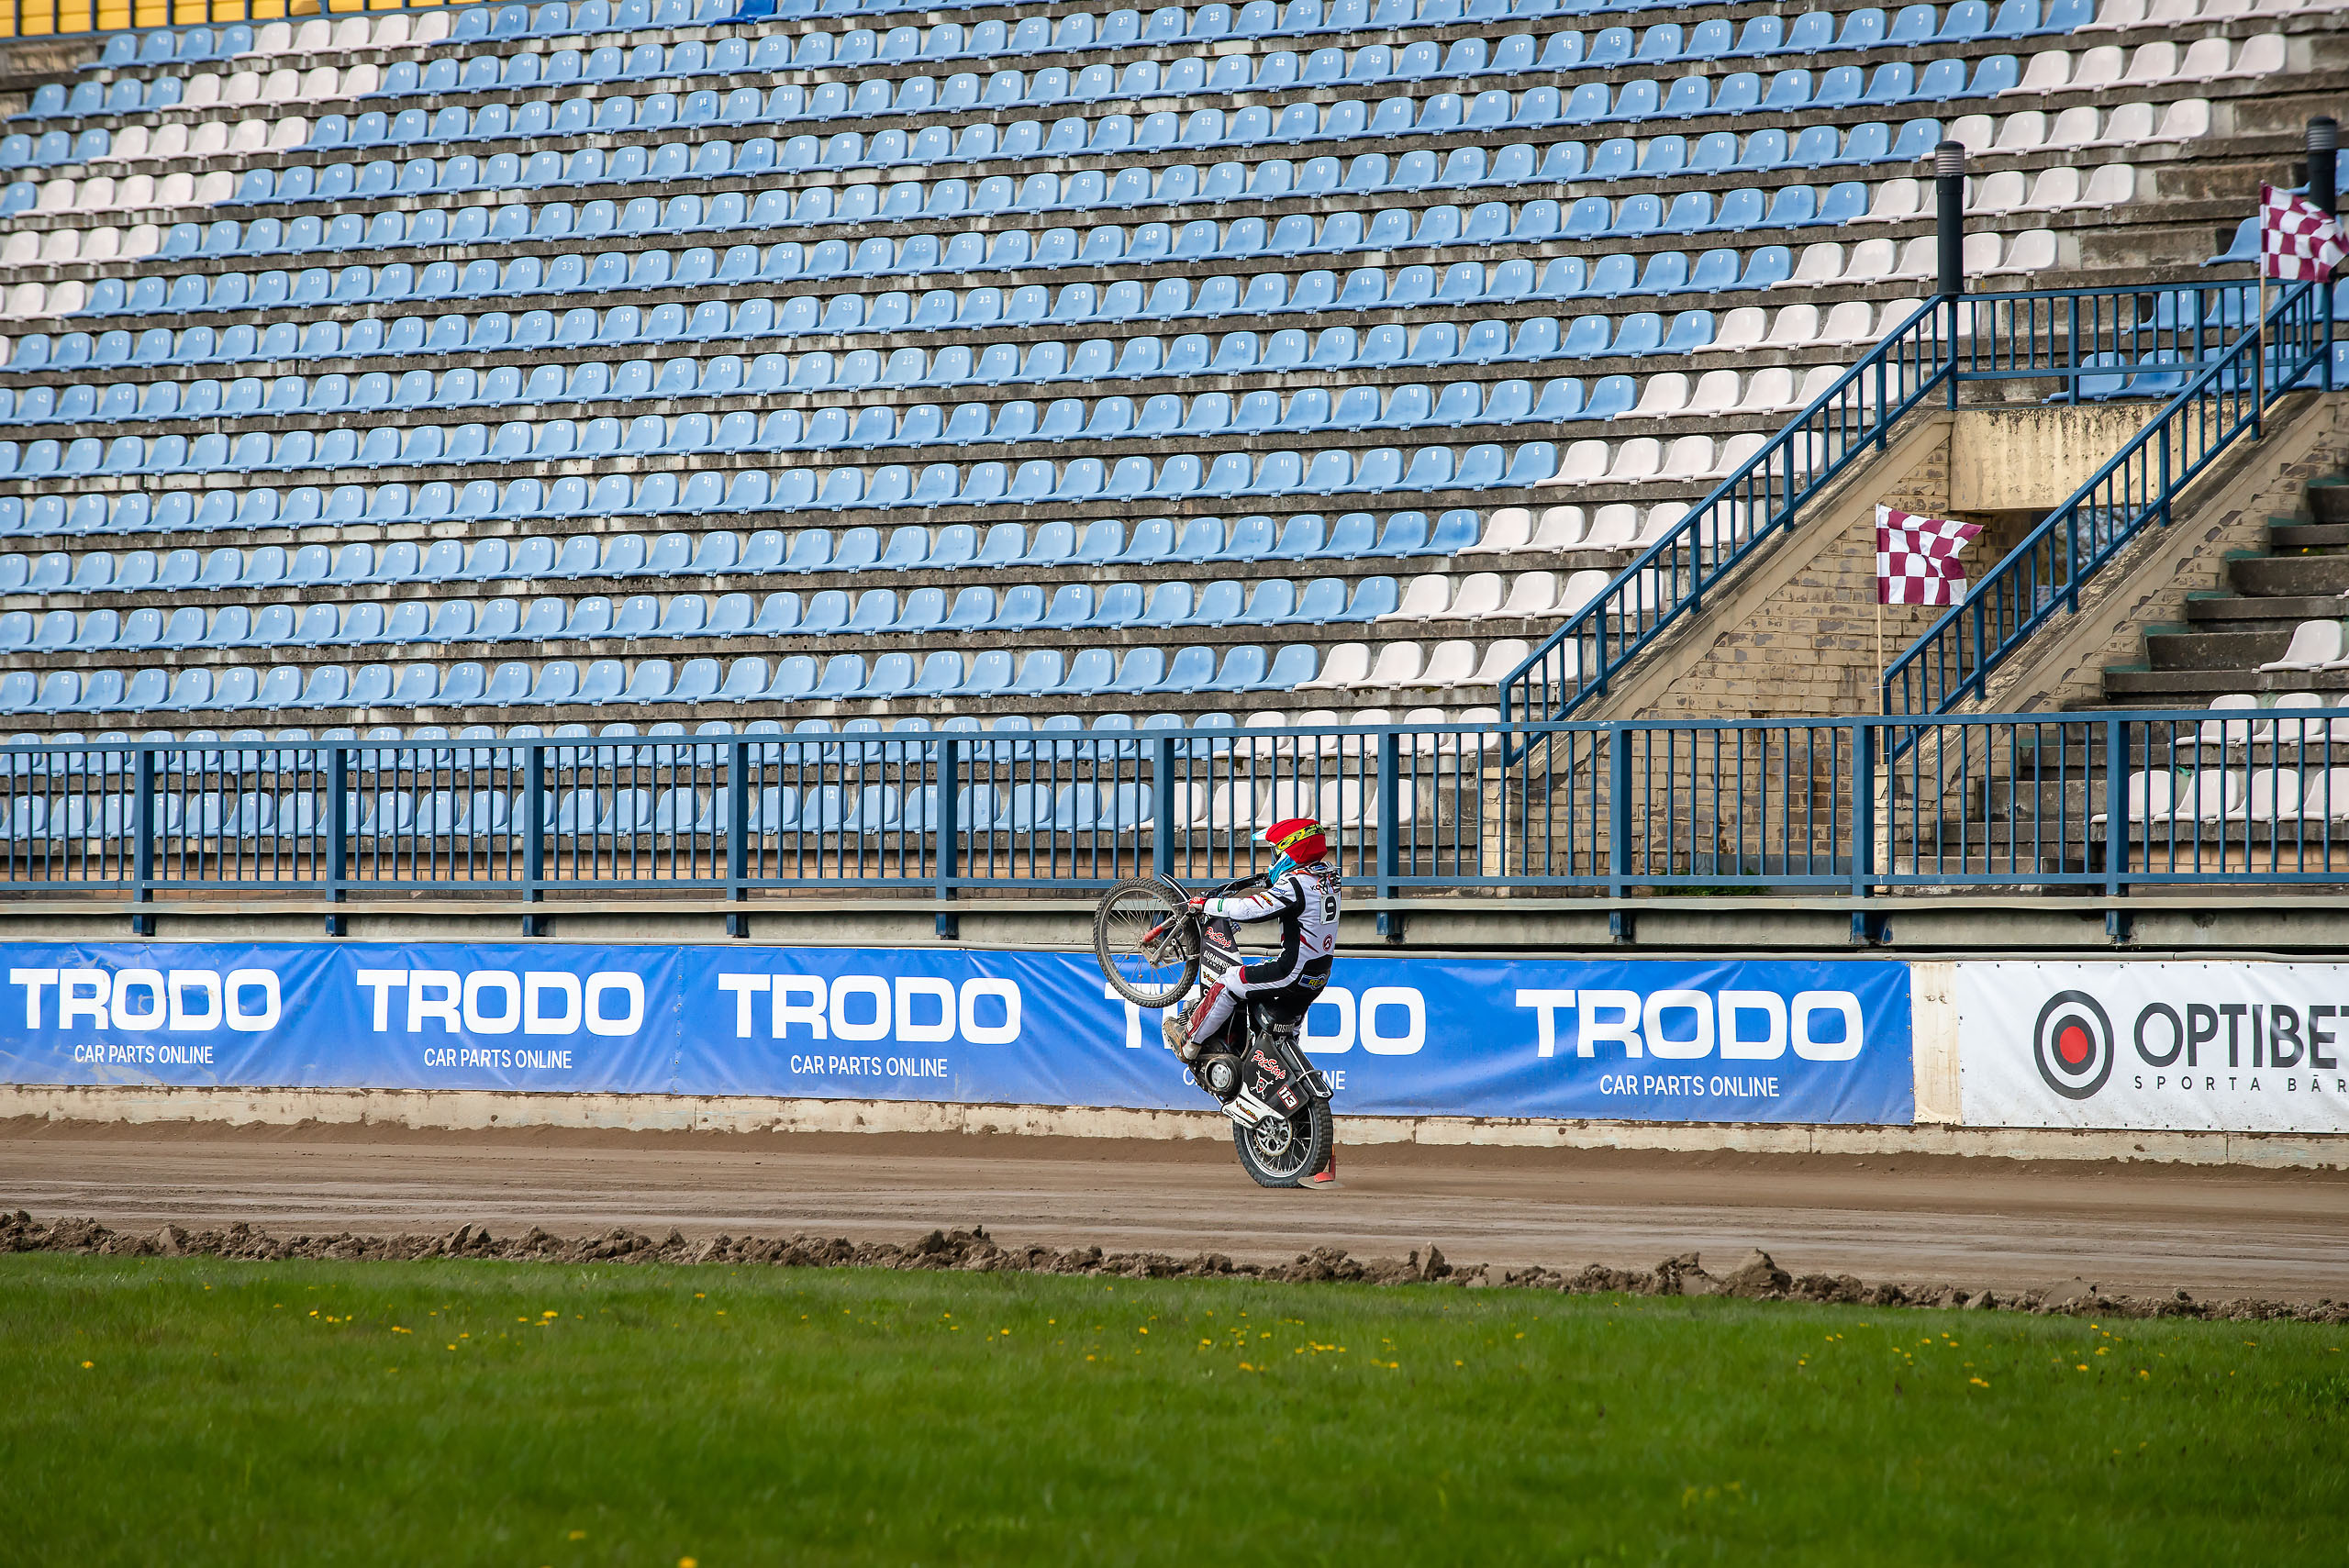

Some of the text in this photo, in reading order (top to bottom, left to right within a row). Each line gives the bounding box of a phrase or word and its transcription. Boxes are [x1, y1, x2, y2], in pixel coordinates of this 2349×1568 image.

[1163, 16, 1174, 26] 26
[1209, 11, 1219, 22] 25
[1709, 28, 1720, 38] 13
[1761, 23, 1772, 34] 12
[898, 33, 909, 43] 32
[1609, 35, 1621, 46] 15
[1660, 32, 1672, 43] 14
[1515, 42, 1526, 52] 17
[1563, 39, 1573, 50] 16
[1275, 58, 1286, 67] 22
[1370, 54, 1381, 64] 20
[1184, 65, 1194, 74] 24
[1230, 61, 1239, 71] 23
[1944, 65, 1951, 74] 7
[698, 97, 707, 106] 35
[1108, 121, 1119, 130] 24
[1201, 117, 1211, 126] 22
[1717, 139, 1725, 149] 10
[1081, 178, 1091, 188] 23
[1127, 174, 1138, 184] 22
[1793, 190, 1799, 199] 7
[1845, 190, 1852, 199] 6
[1587, 205, 1596, 213] 11
[1638, 201, 1649, 211] 10
[1486, 209, 1497, 218] 13
[1535, 207, 1545, 217] 12
[1098, 234, 1109, 243] 21
[1145, 229, 1158, 240] 20
[1053, 235, 1065, 245] 22
[604, 259, 615, 269] 32
[1719, 254, 1724, 264] 7
[562, 261, 573, 272] 33
[1512, 266, 1520, 276] 11
[1564, 264, 1575, 274] 10
[1314, 278, 1322, 287] 15
[1361, 276, 1371, 286] 14
[1217, 282, 1226, 291] 17
[1264, 282, 1274, 291] 16
[978, 295, 991, 304] 22
[1027, 293, 1038, 303] 21
[1074, 290, 1086, 300] 20
[842, 301, 853, 311] 25
[933, 298, 945, 307] 23
[1641, 317, 1647, 328] 7
[1691, 317, 1698, 328] 6
[1383, 332, 1392, 343] 12
[1436, 330, 1444, 340] 11
[1486, 329, 1495, 339] 10
[1186, 343, 1196, 352] 16
[1236, 340, 1245, 350] 15
[1563, 382, 1569, 392] 7
[1259, 395, 1268, 406] 13
[1360, 391, 1368, 401] 11
[1484, 450, 1490, 460] 7
[1280, 458, 1289, 467] 11
[1152, 523, 1161, 534] 12
[1252, 521, 1264, 531] 10
[764, 535, 776, 545] 20
[1071, 587, 1081, 599] 12
[586, 600, 601, 612] 22
[508, 666, 520, 676] 22
[1212, 716, 1219, 726] 6
[760, 725, 770, 735] 15
[1324, 895, 1337, 921] 9
[9, 968, 282, 1032] TRODO
[356, 969, 645, 1037] TRODO
[718, 973, 1022, 1045] TRODO
[1515, 988, 1864, 1062] TRODO
[2133, 1002, 2349, 1070] OPTIBE
[74, 1044, 214, 1064] CAR PARTS ONLINE
[424, 1048, 573, 1069] CAR PARTS ONLINE
[790, 1054, 948, 1078] CAR PARTS ONLINE
[1252, 1050, 1286, 1080] PitStop
[1599, 1073, 1780, 1097] CAR PARTS ONLINE
[2134, 1073, 2347, 1093] SPORTA BĀR
[1279, 1086, 1297, 1108] 113
